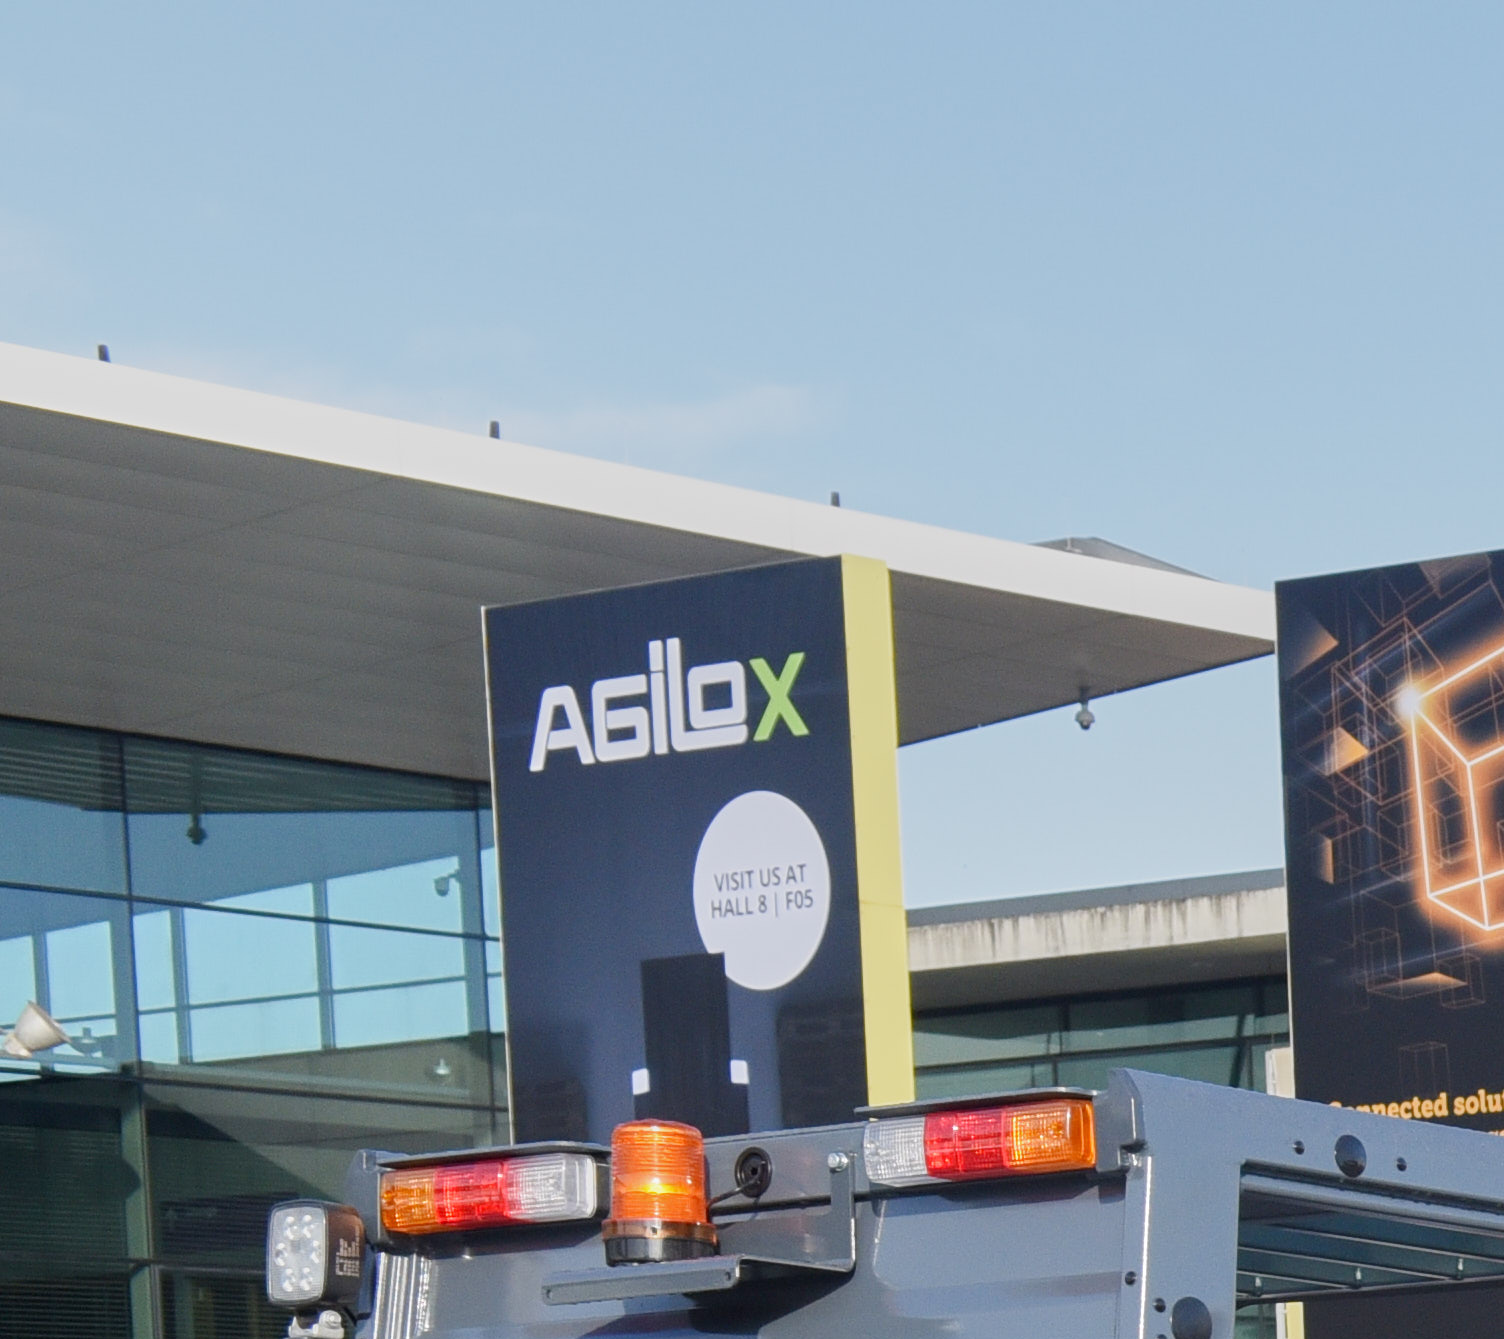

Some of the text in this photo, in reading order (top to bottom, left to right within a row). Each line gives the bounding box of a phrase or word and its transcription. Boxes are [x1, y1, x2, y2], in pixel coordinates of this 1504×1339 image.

[713, 863, 807, 894] VISIT US AT
[710, 896, 753, 919] HALL
[757, 892, 768, 913] 8
[784, 889, 815, 912] F05
